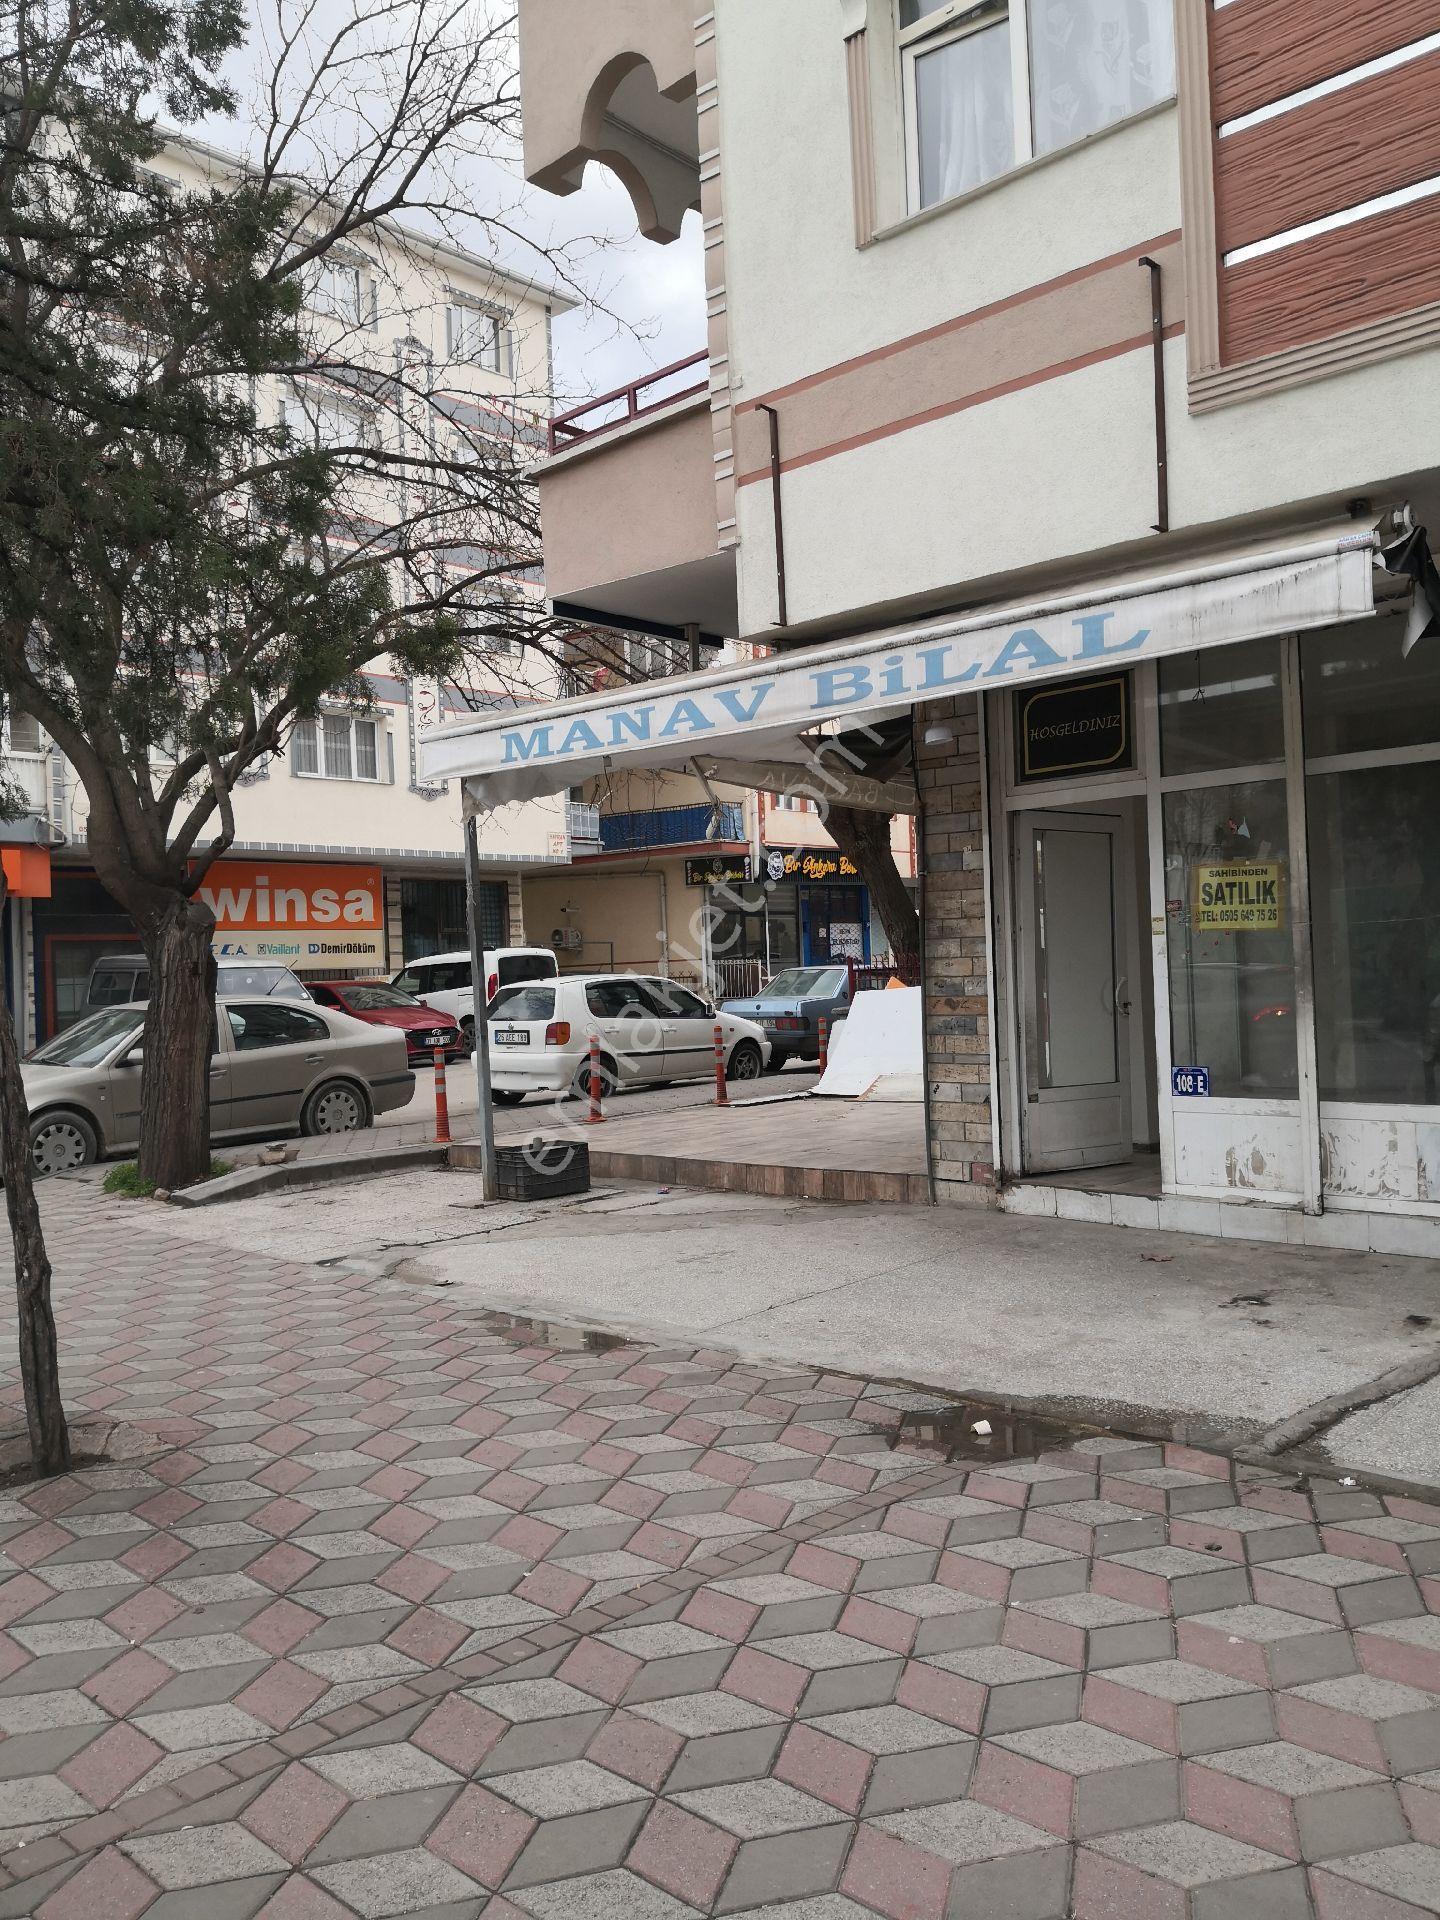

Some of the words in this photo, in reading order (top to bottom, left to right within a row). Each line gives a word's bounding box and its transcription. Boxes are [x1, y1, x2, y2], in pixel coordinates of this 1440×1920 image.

[502, 681, 776, 764] MANAV
[199, 875, 376, 923] winsa
[1201, 880, 1277, 907] SATILIK
[1201, 911, 1218, 922] TEL:
[1257, 909, 1266, 921] 75
[1267, 908, 1278, 921] 26
[265, 943, 301, 955] Vaillant
[320, 942, 376, 954] DemirDöküm
[1176, 1074, 1204, 1093] 108-E
